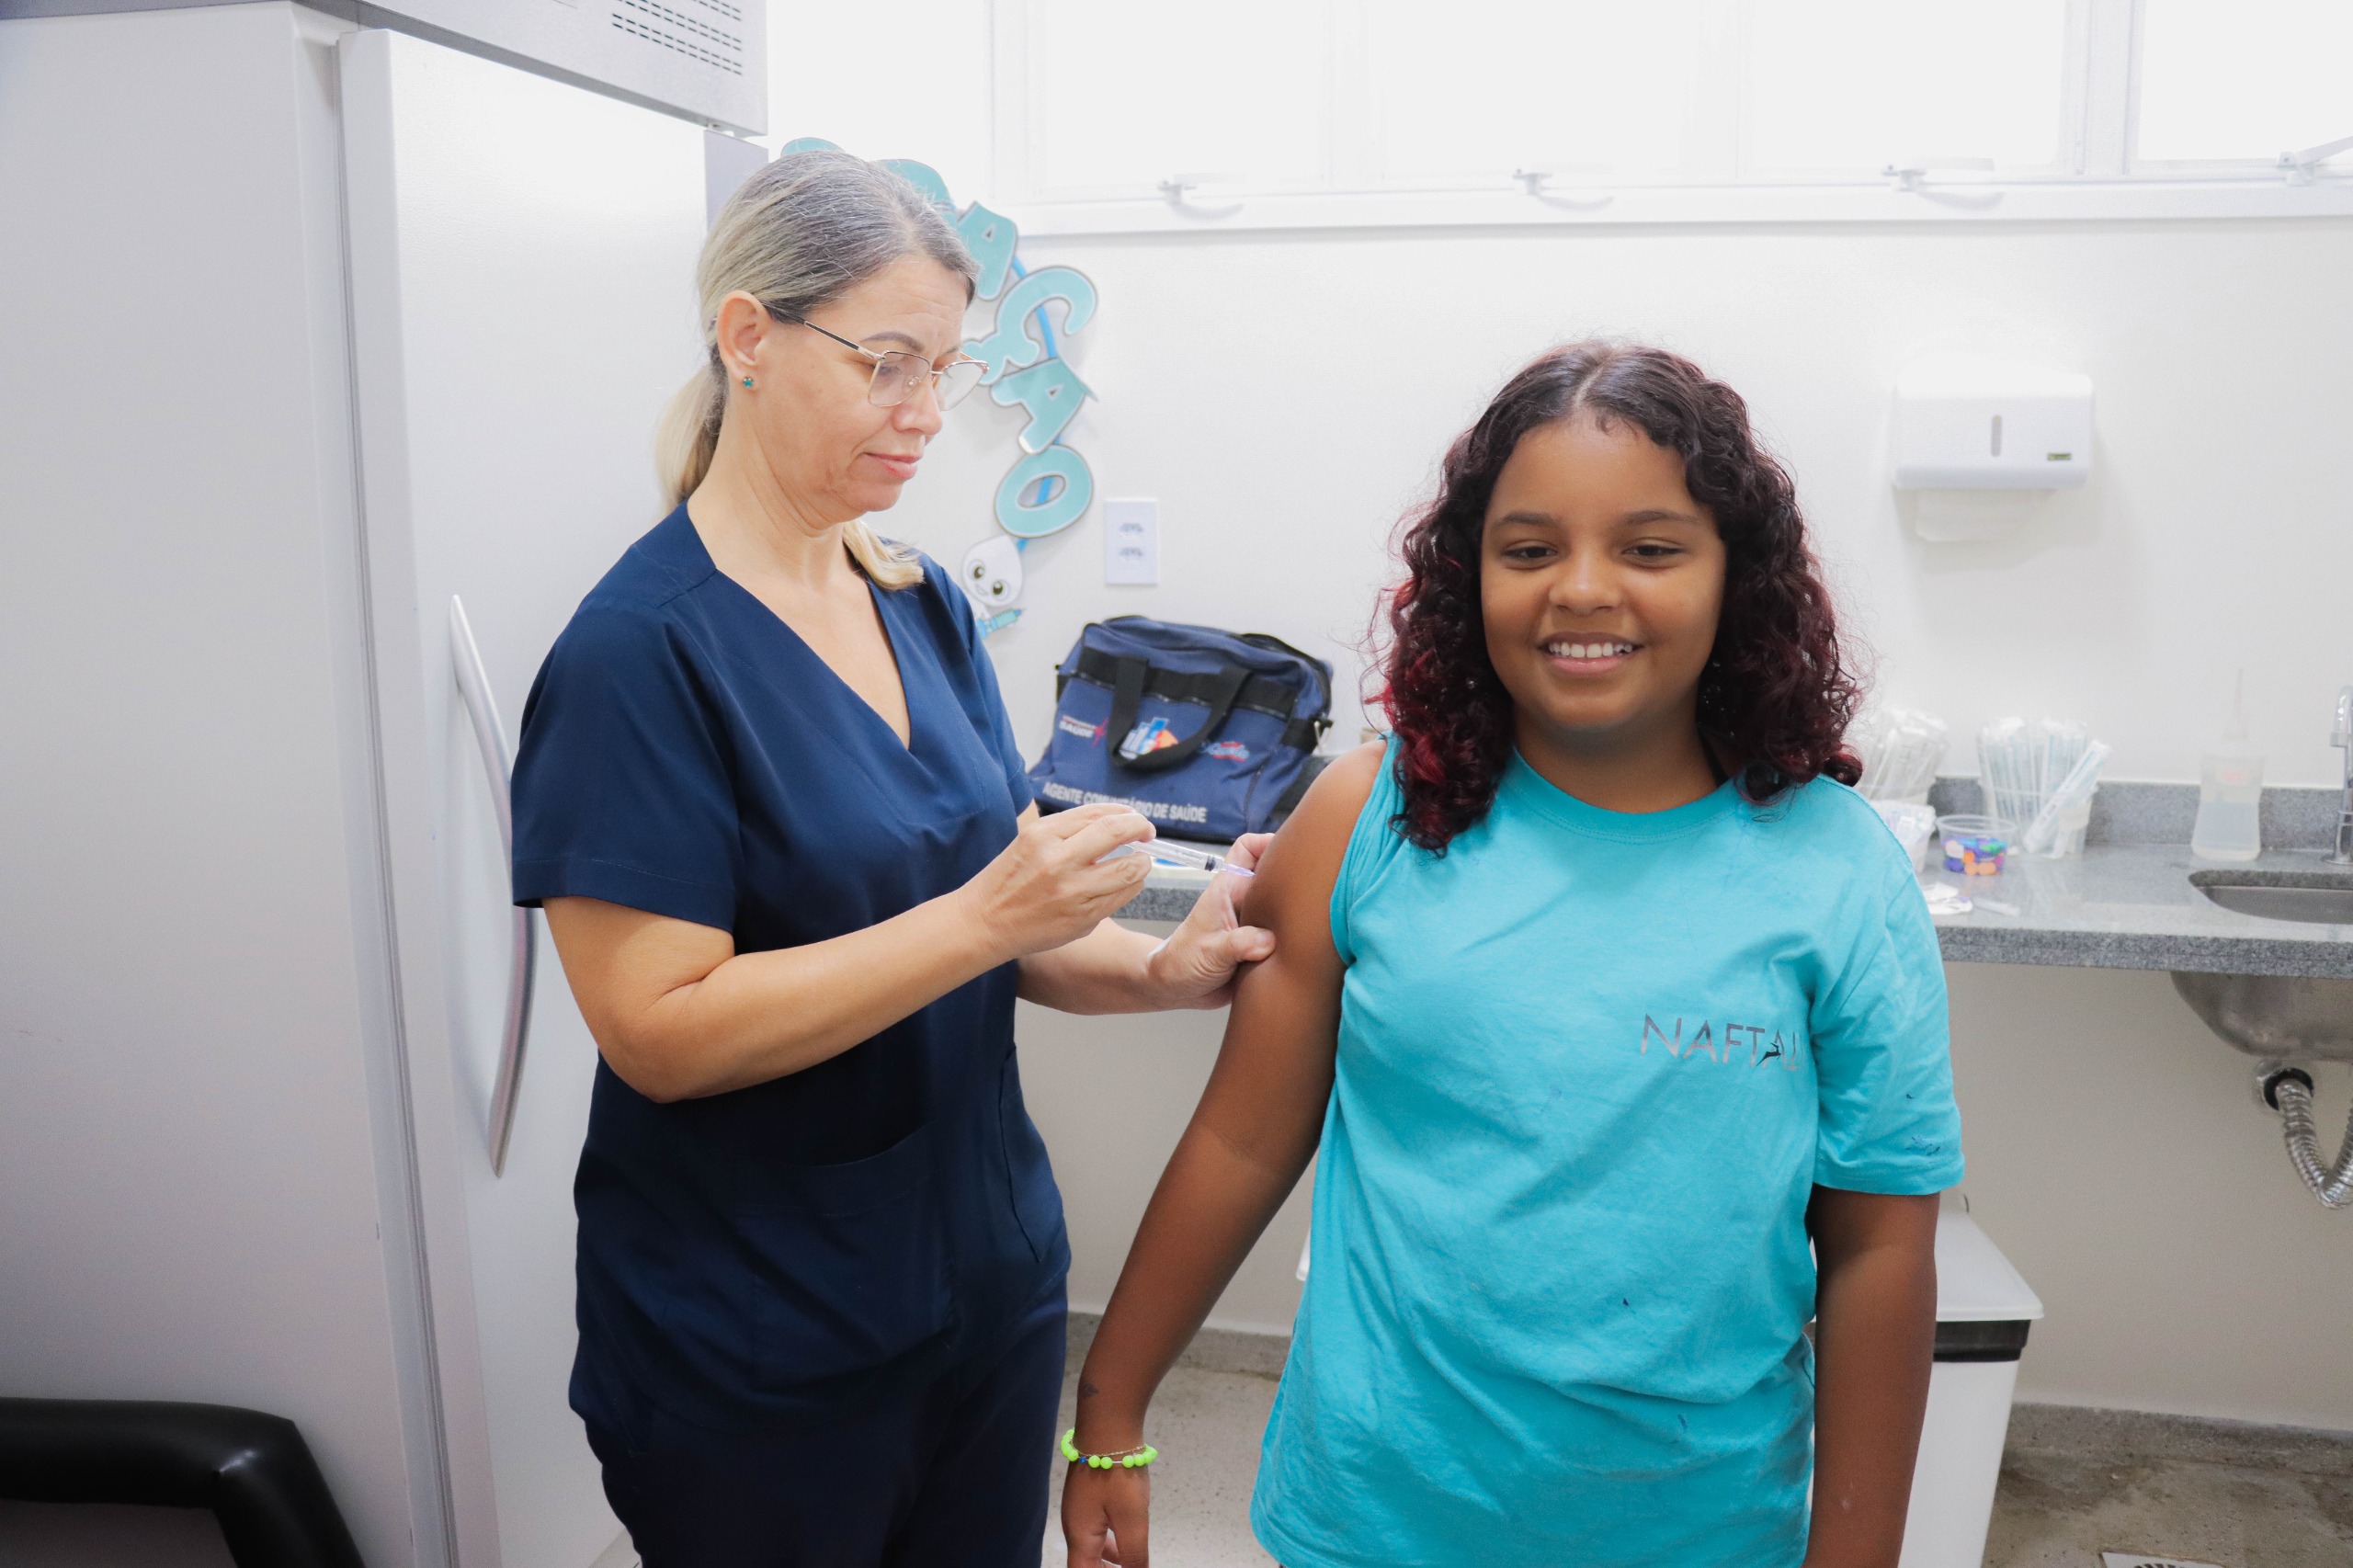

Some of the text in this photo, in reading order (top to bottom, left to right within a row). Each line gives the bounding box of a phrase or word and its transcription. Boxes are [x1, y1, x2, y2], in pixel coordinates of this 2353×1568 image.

[1043, 782, 1083, 804] AGENTE
[1154, 803, 1170, 819] DE
[1170, 803, 1207, 824] SAÚDE
[1641, 1013, 1804, 1071] NAFTAL
